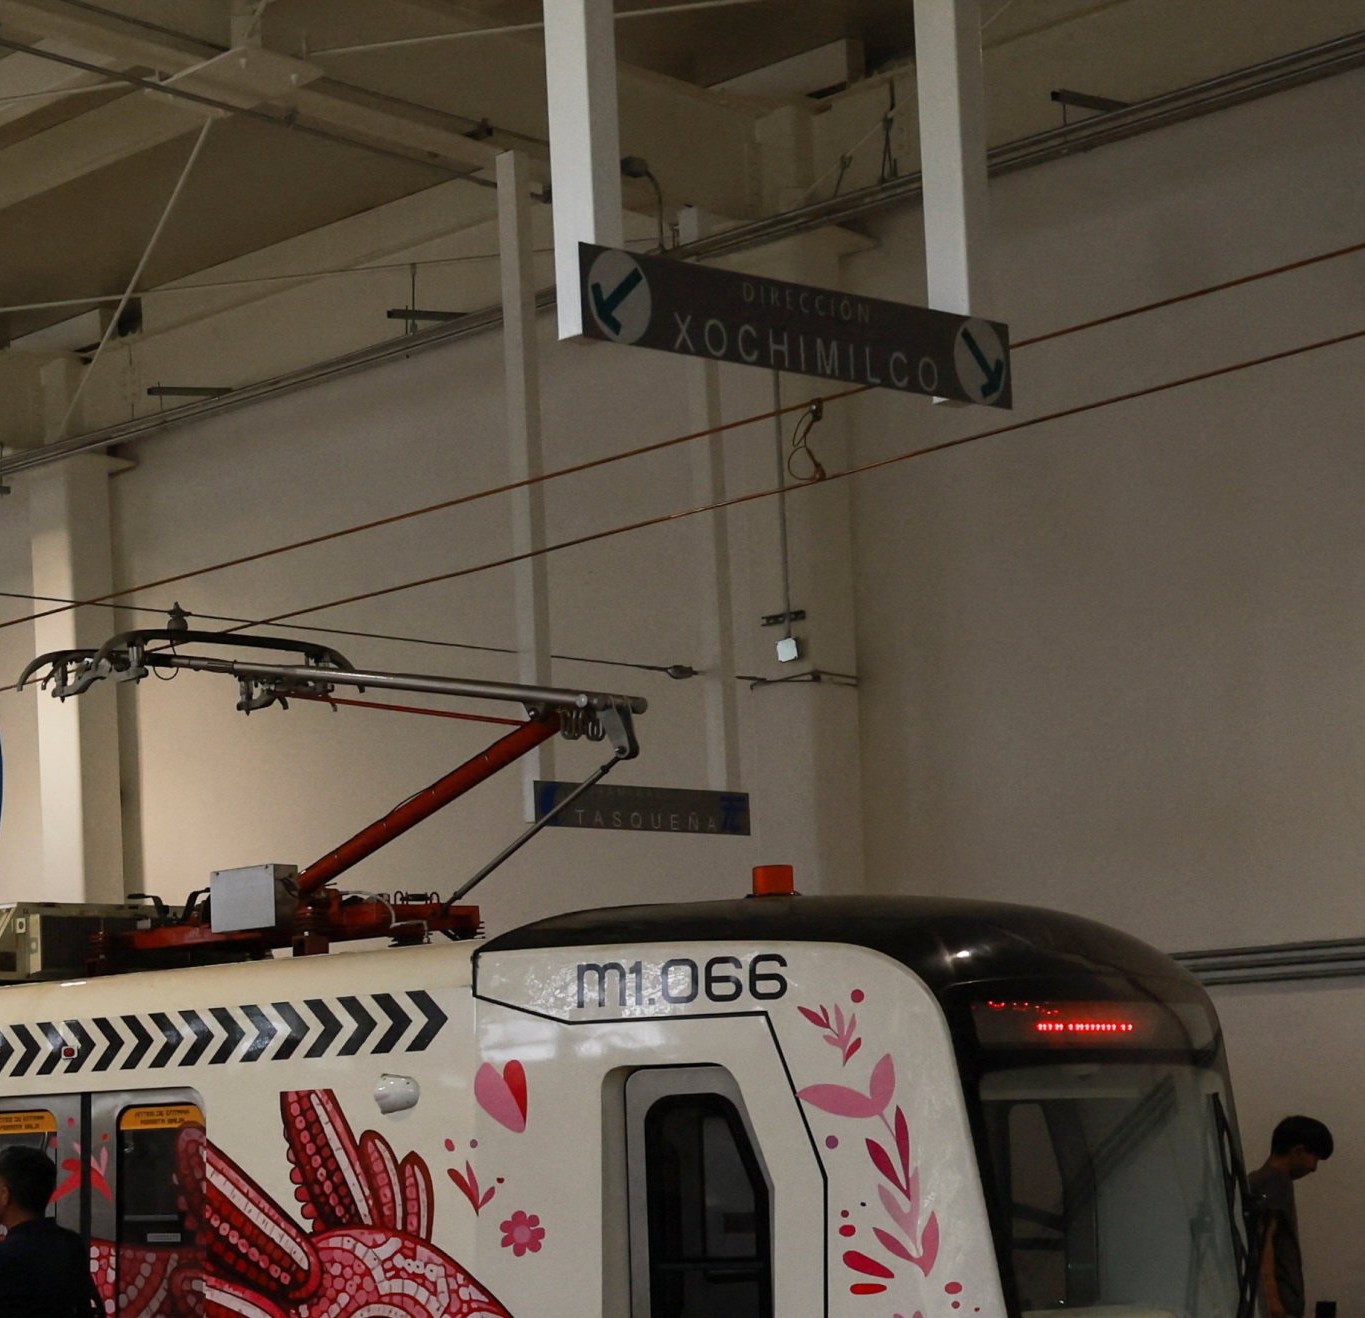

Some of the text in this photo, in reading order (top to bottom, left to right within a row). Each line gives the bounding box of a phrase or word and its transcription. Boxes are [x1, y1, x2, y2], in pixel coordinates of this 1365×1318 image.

[742, 282, 871, 325] DIRECCIÓN
[673, 311, 939, 393] XOCHIMILCO
[574, 808, 717, 833] TASQUEÑA
[576, 953, 788, 1009] m1.066
